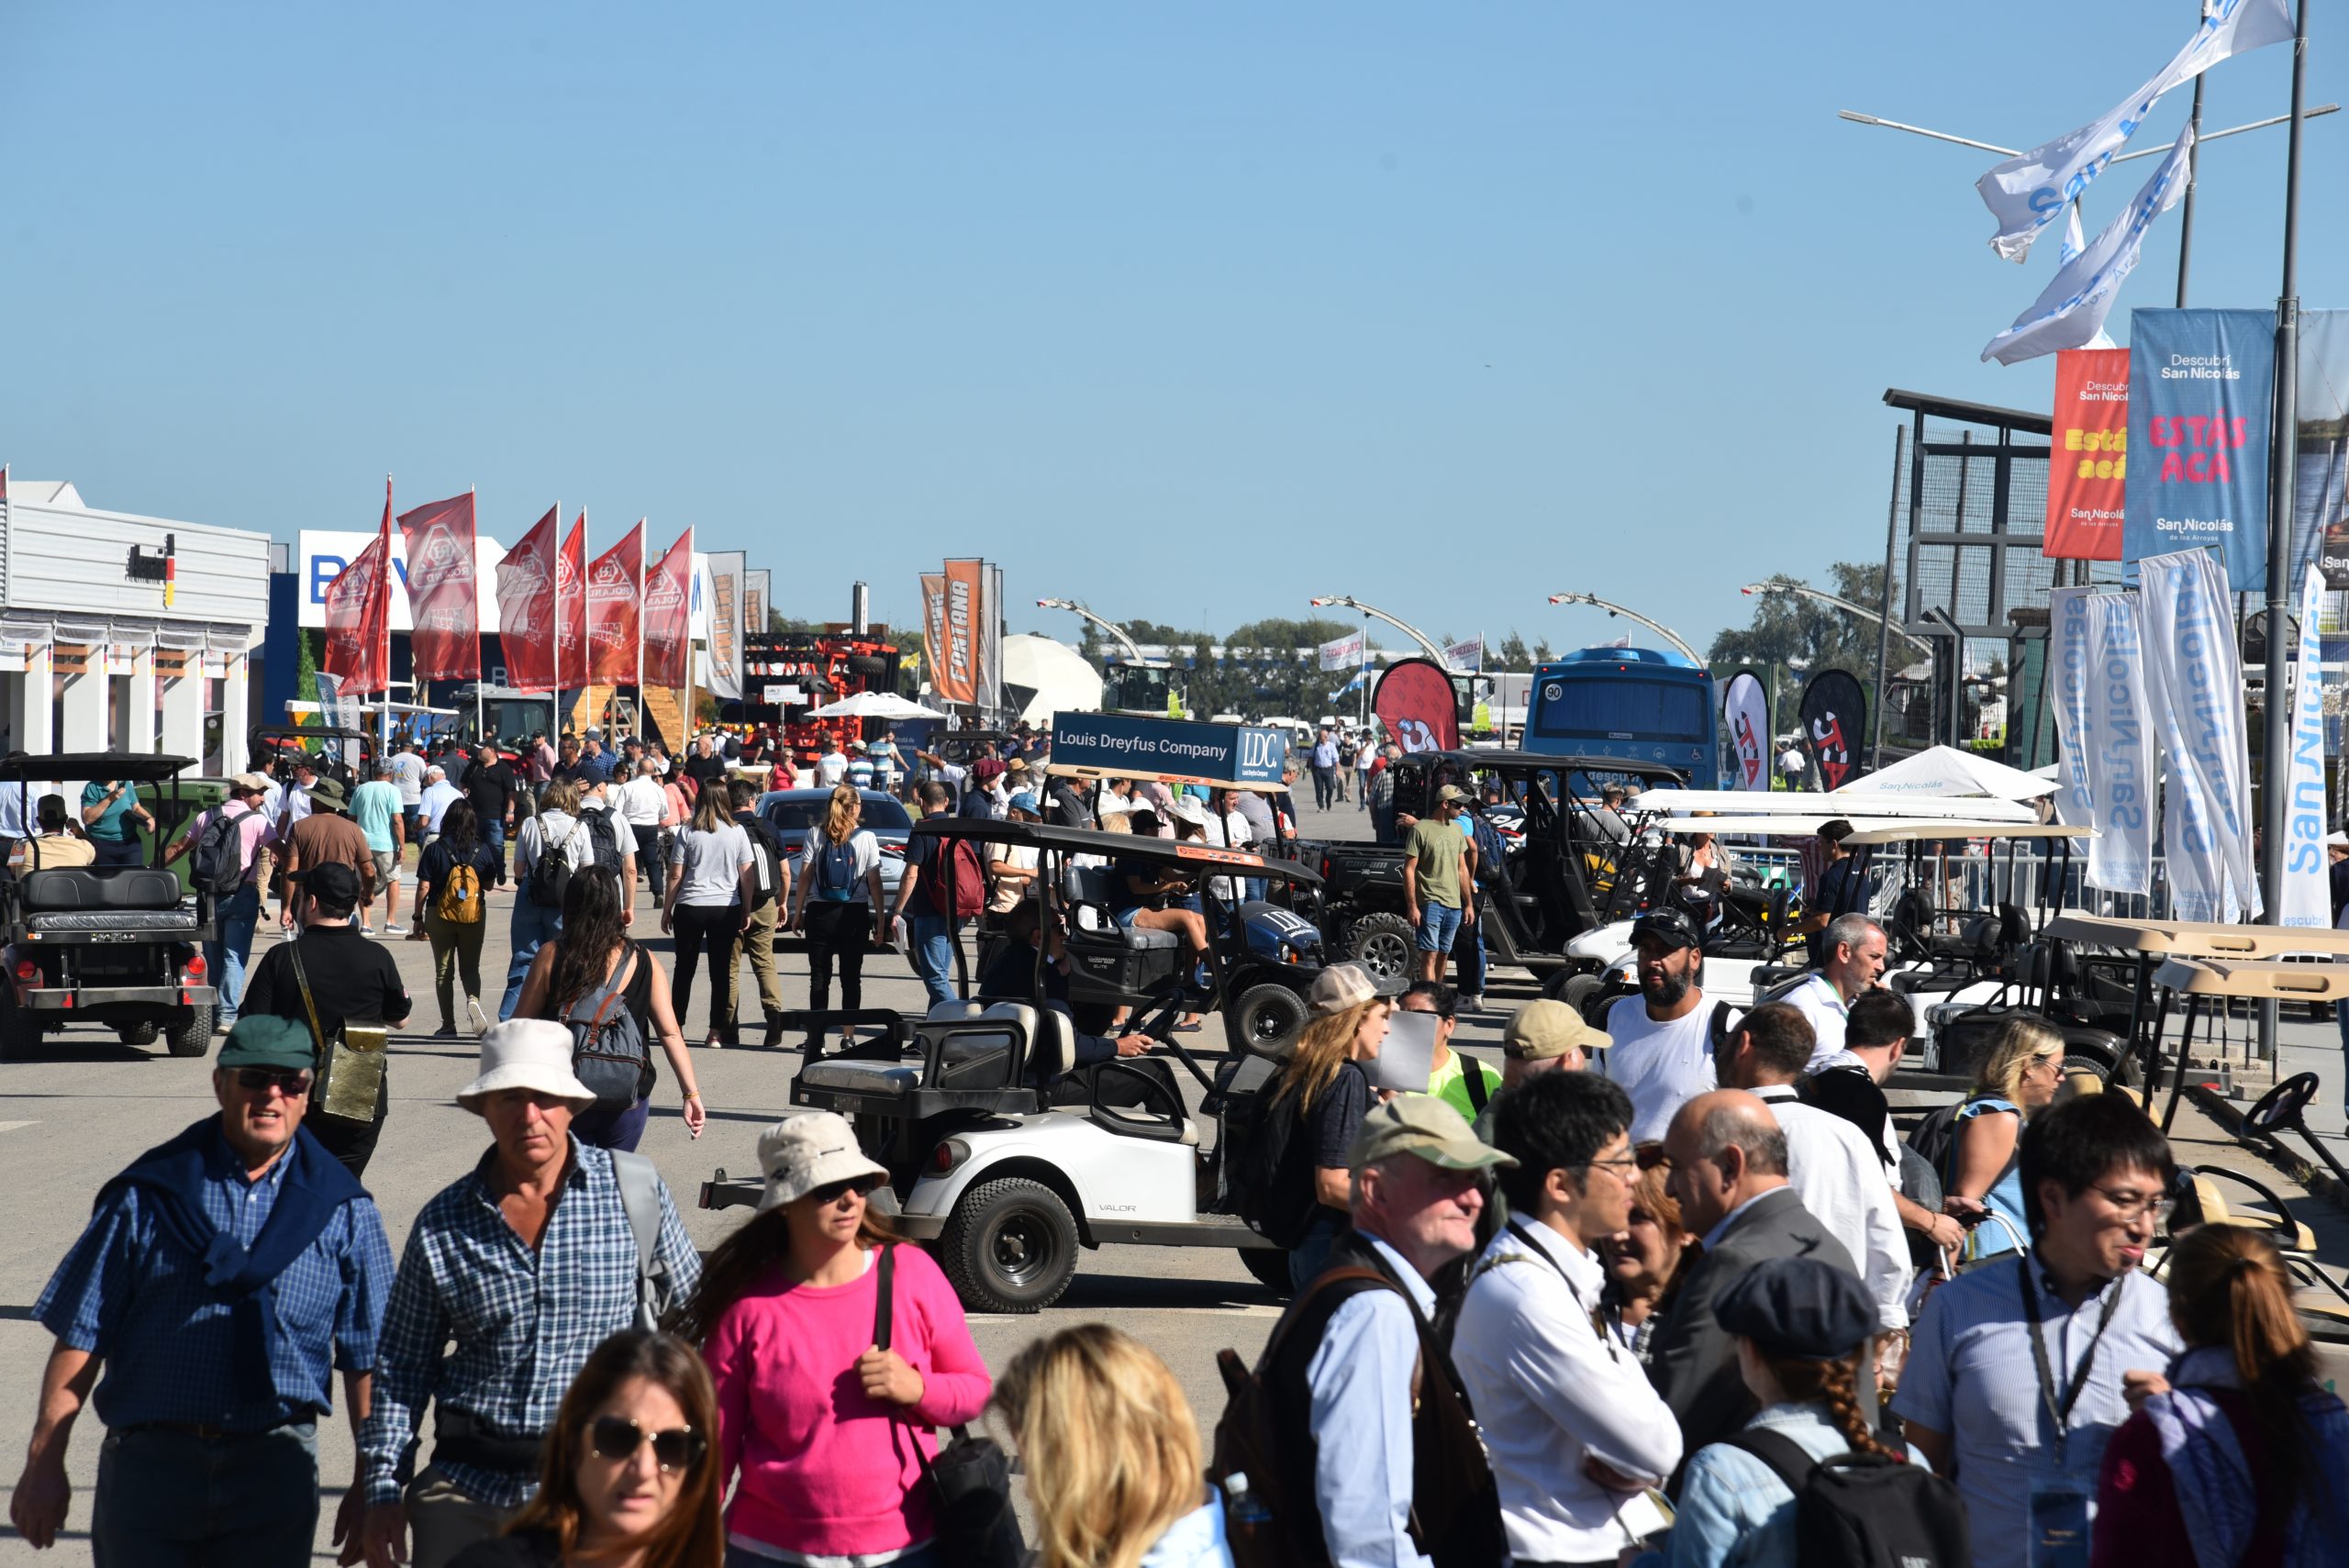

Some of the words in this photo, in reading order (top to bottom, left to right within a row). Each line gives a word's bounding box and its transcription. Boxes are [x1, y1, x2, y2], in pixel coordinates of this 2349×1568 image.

[2171, 354, 2231, 366] Descubrí
[2161, 367, 2188, 379] San
[2190, 367, 2240, 380] Nicolás
[2087, 381, 2129, 391] Descubr
[2079, 391, 2099, 401] San
[2101, 391, 2128, 401] Nicol
[2149, 407, 2247, 450] ESTÁS
[2065, 428, 2127, 452] Está
[2071, 508, 2091, 521] San
[2089, 508, 2125, 520] Nicolá
[2156, 518, 2182, 533] San
[2182, 518, 2234, 532] Nicolás
[1547, 686, 1561, 698] 90
[1059, 729, 1097, 746] Louis
[1100, 733, 1156, 752] Dreyfus
[1159, 740, 1228, 762] Company
[2288, 782, 2324, 873] San
[1098, 1204, 1137, 1212] VALOR
